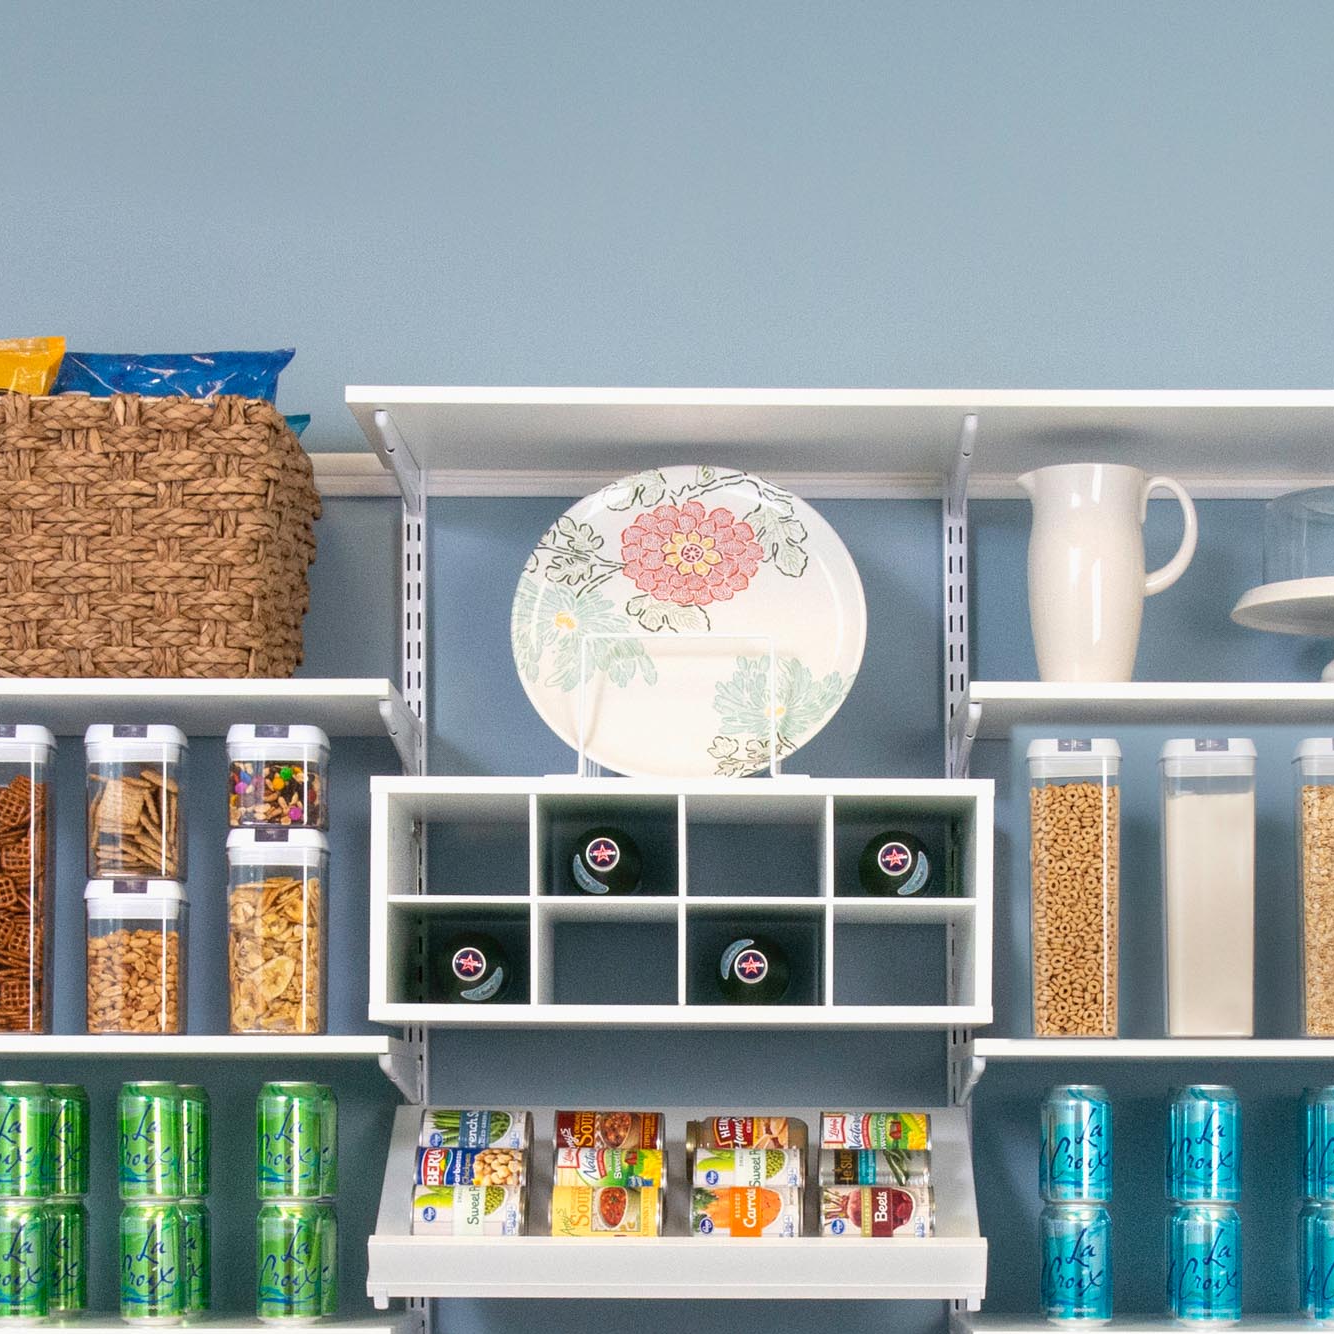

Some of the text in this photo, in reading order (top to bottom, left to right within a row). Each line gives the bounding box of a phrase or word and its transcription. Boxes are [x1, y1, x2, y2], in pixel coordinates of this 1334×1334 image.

[132, 1103, 157, 1144] La
[274, 1103, 304, 1144] La
[466, 1117, 479, 1150] rench
[560, 1127, 580, 1150] my's
[718, 1117, 731, 1139] HEIN
[1075, 1107, 1104, 1148] La
[1195, 1107, 1227, 1149] La
[426, 1149, 444, 1186] BERIA
[1051, 1136, 1109, 1181] Croix
[468, 1192, 479, 1226] Sweet
[874, 1191, 888, 1222] Beets
[2, 1223, 35, 1265] La
[136, 1223, 166, 1265] La
[280, 1224, 310, 1265] La
[1066, 1227, 1097, 1268] La
[1202, 1227, 1232, 1269] La
[1049, 1256, 1104, 1299] Croix
[1178, 1257, 1238, 1301] Croix
